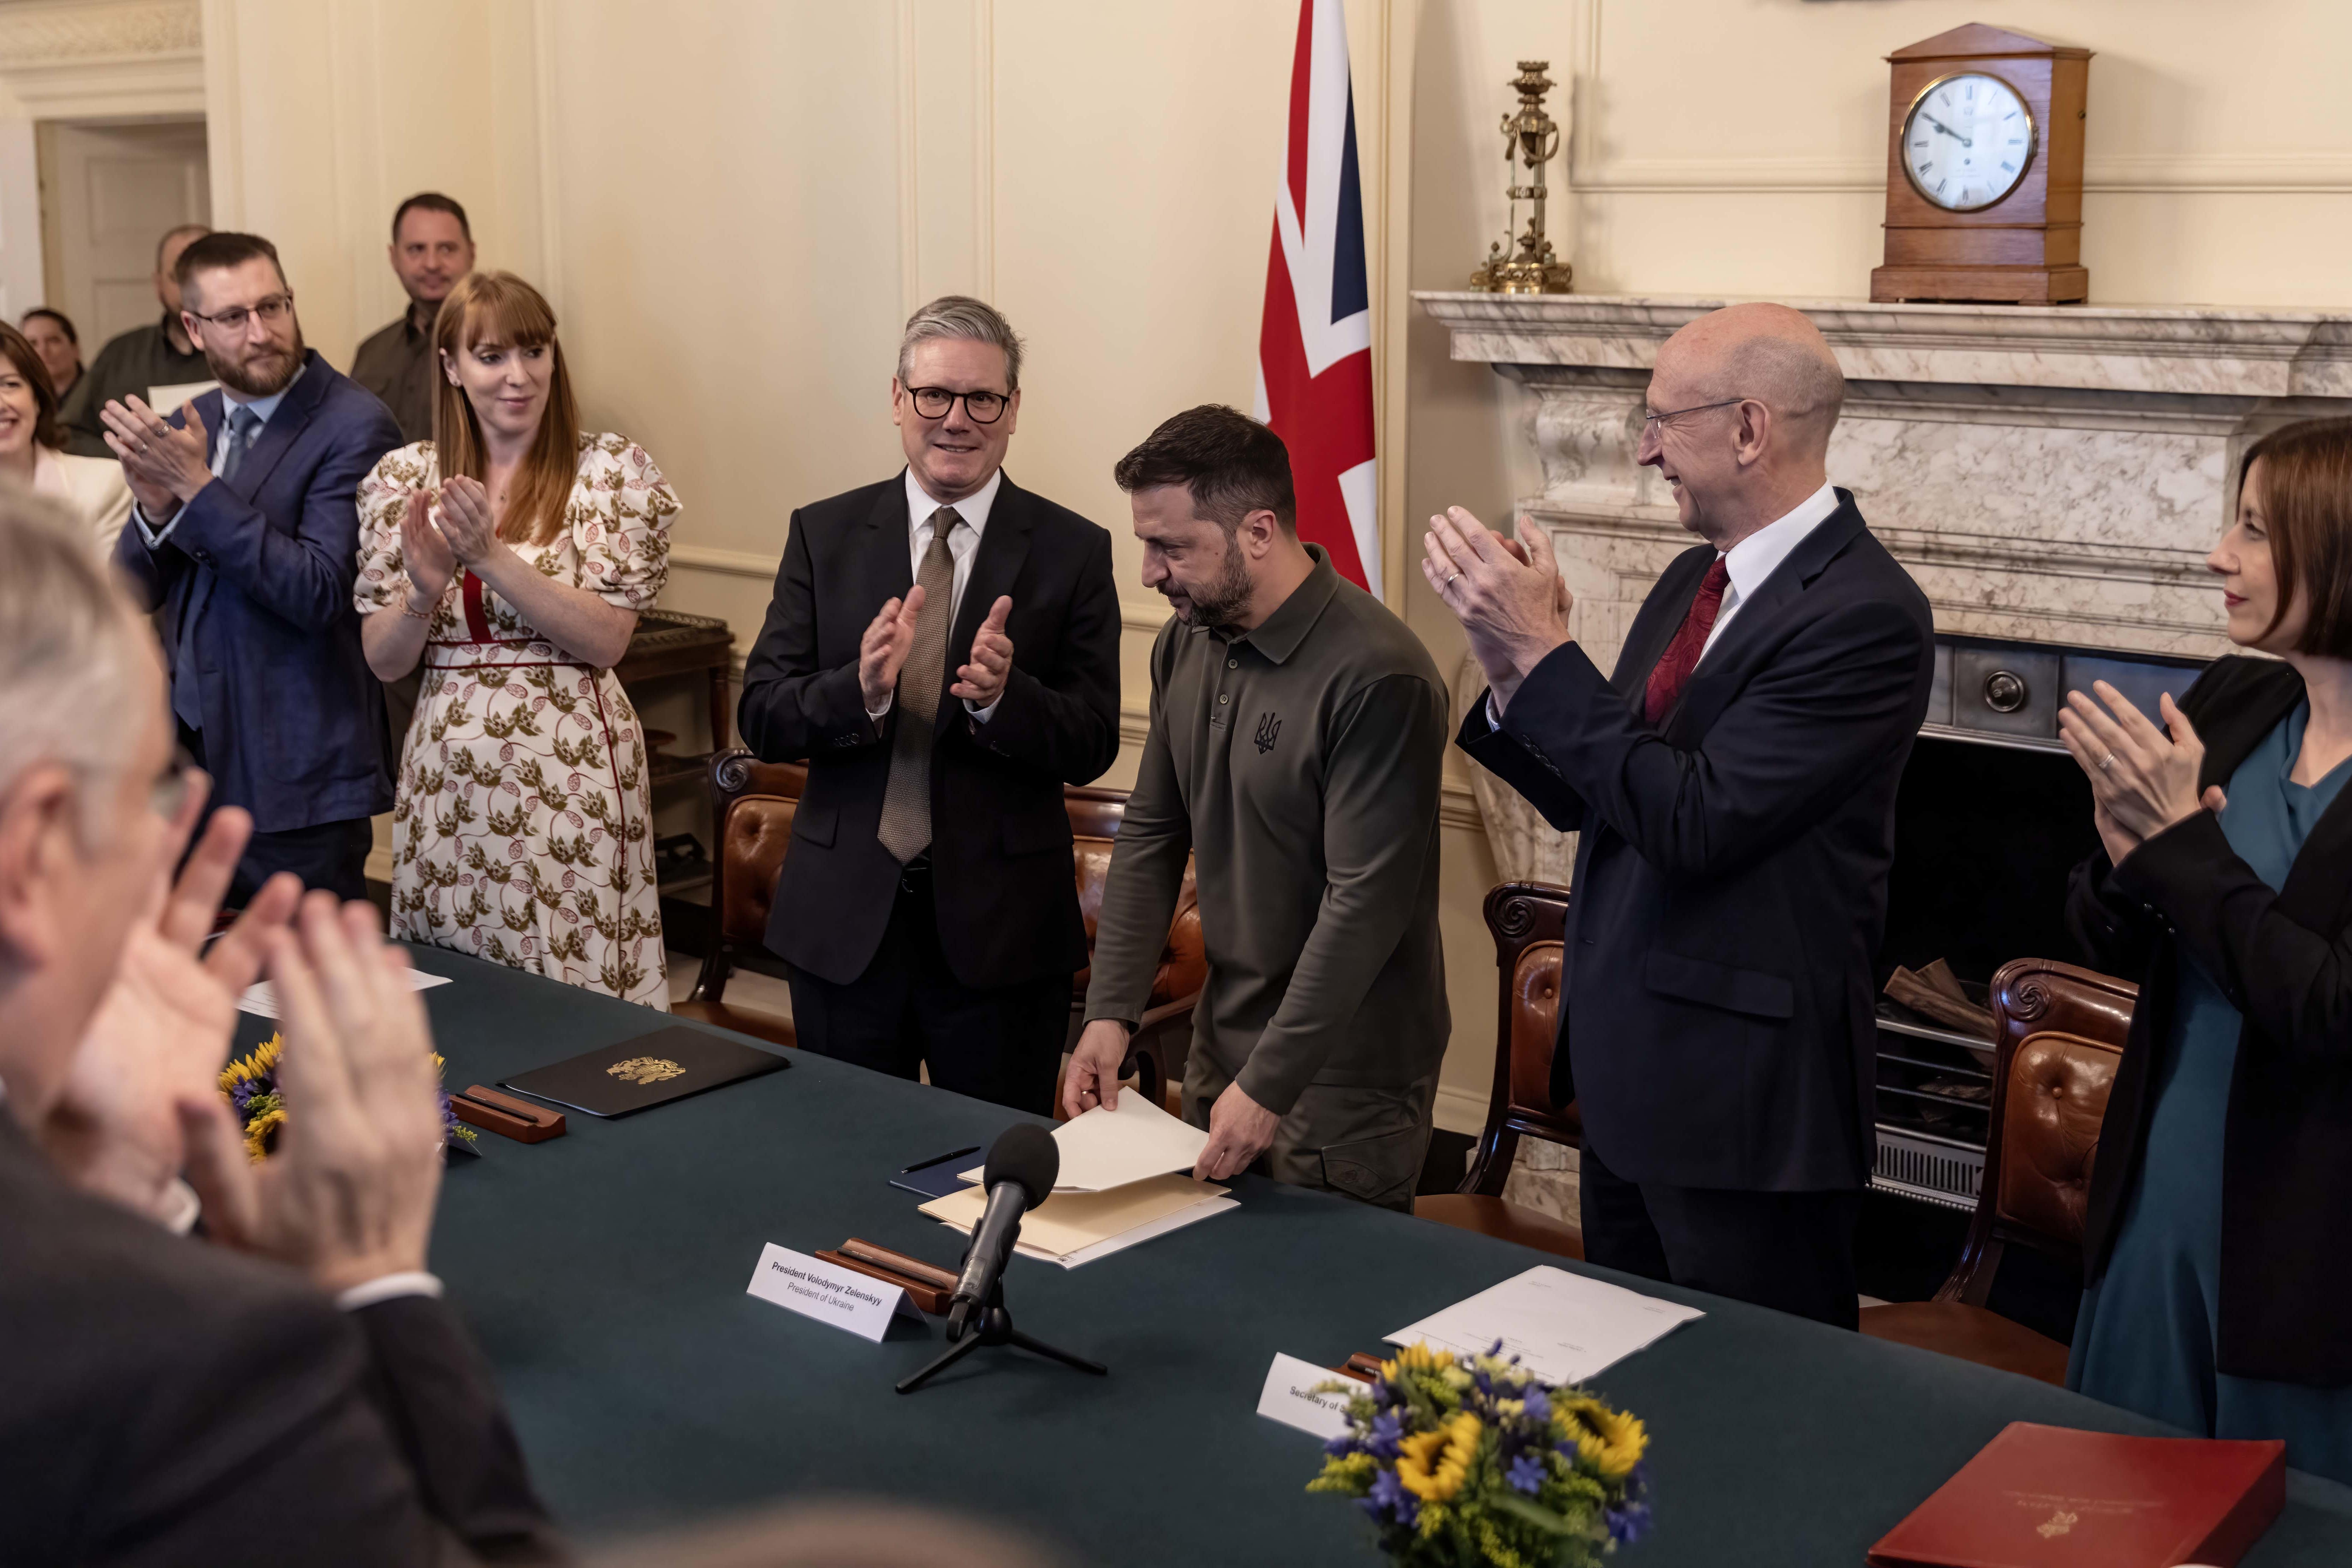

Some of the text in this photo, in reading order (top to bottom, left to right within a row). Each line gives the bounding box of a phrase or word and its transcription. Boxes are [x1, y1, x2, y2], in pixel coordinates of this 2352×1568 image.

[772, 1261, 882, 1306] President Volodymyr Zelenskyy
[787, 1282, 854, 1311] President of Ukraine
[1290, 1386, 1328, 1408] Secretary
[1329, 1401, 1339, 1410] of
